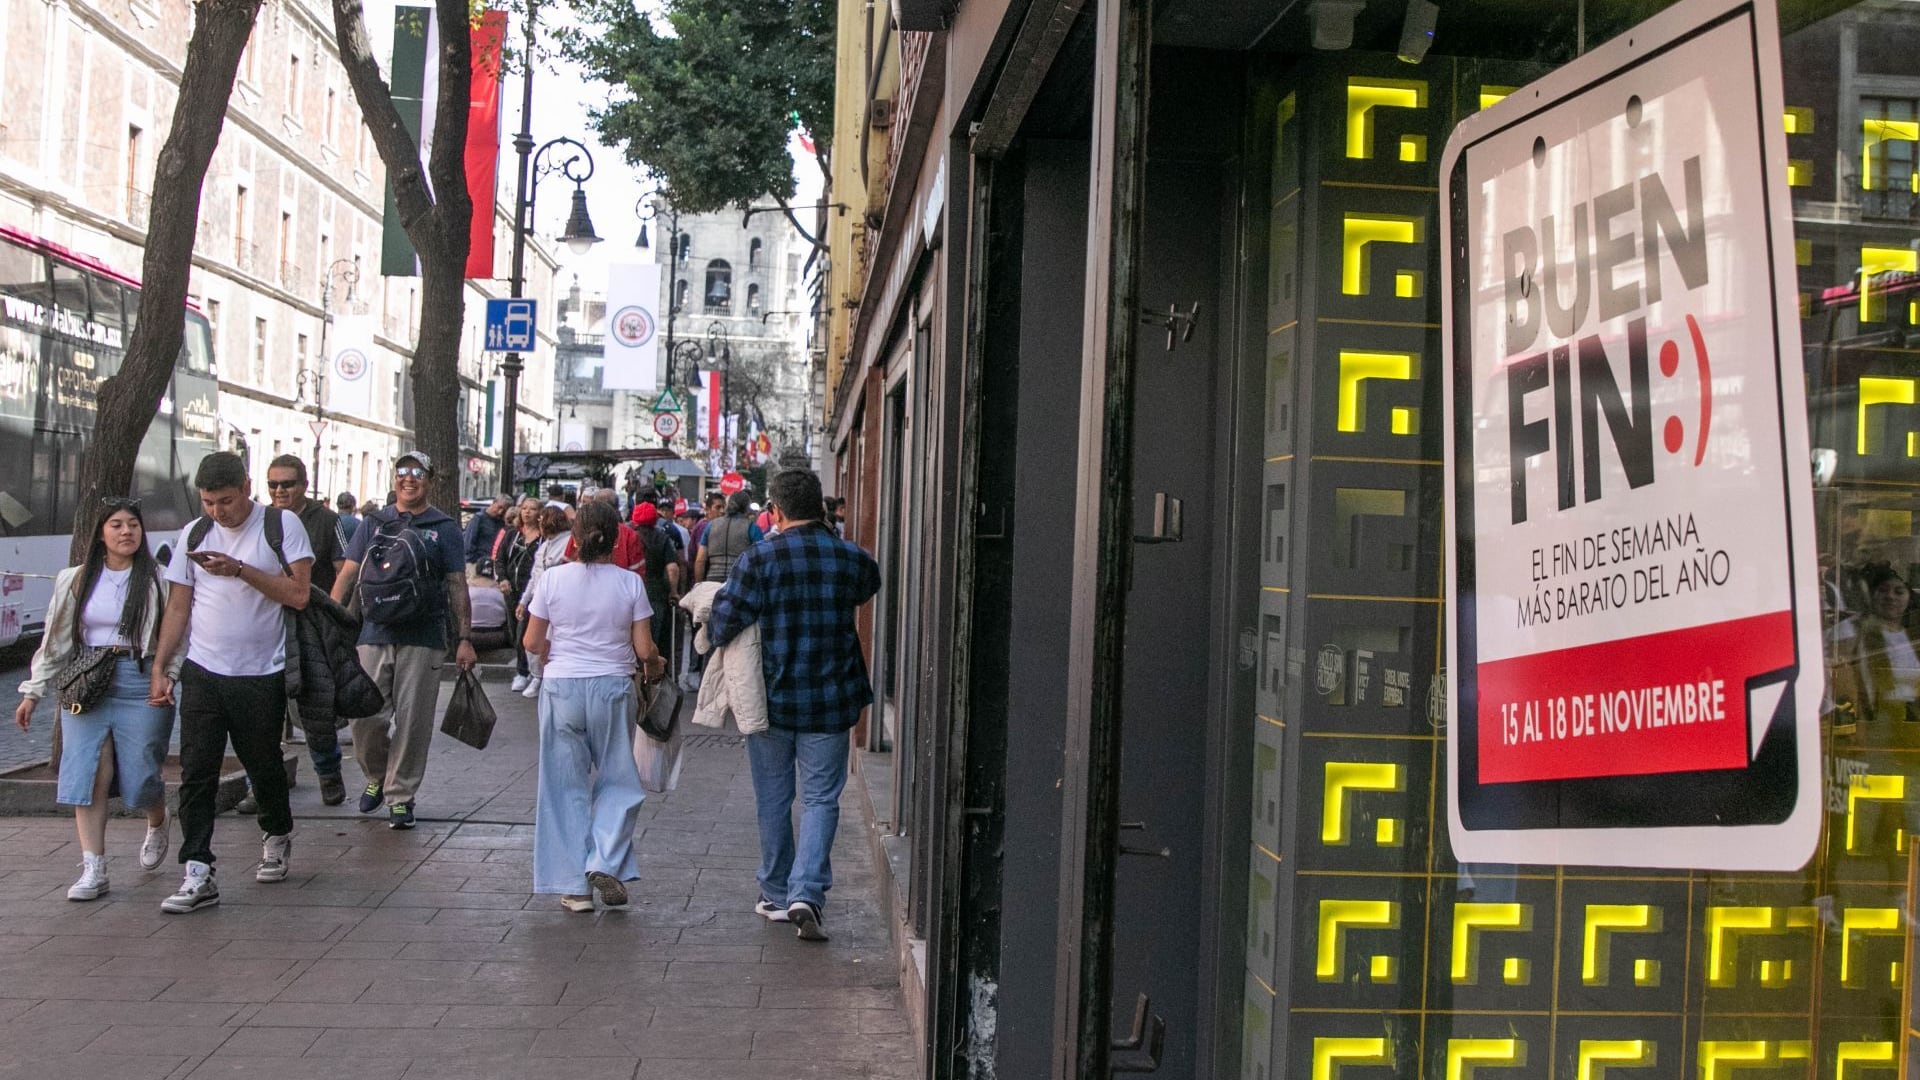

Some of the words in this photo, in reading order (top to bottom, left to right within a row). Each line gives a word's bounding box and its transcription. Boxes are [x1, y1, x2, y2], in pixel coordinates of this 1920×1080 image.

[1503, 156, 1709, 357] BUEN
[1532, 548, 1549, 582] EL
[1553, 540, 1577, 577] FIN
[1583, 533, 1606, 570] DE
[1611, 512, 1699, 564] SEMANA
[1517, 583, 1551, 629] MÁS
[1557, 573, 1627, 620] BARATO
[1634, 564, 1669, 604] DEL
[1676, 547, 1730, 595] AÑO
[1501, 702, 1518, 745] 15
[1522, 700, 1543, 743] AL
[1547, 697, 1567, 740] 18
[1572, 694, 1595, 737] DE
[1599, 680, 1725, 734] NOVIEMBRE
